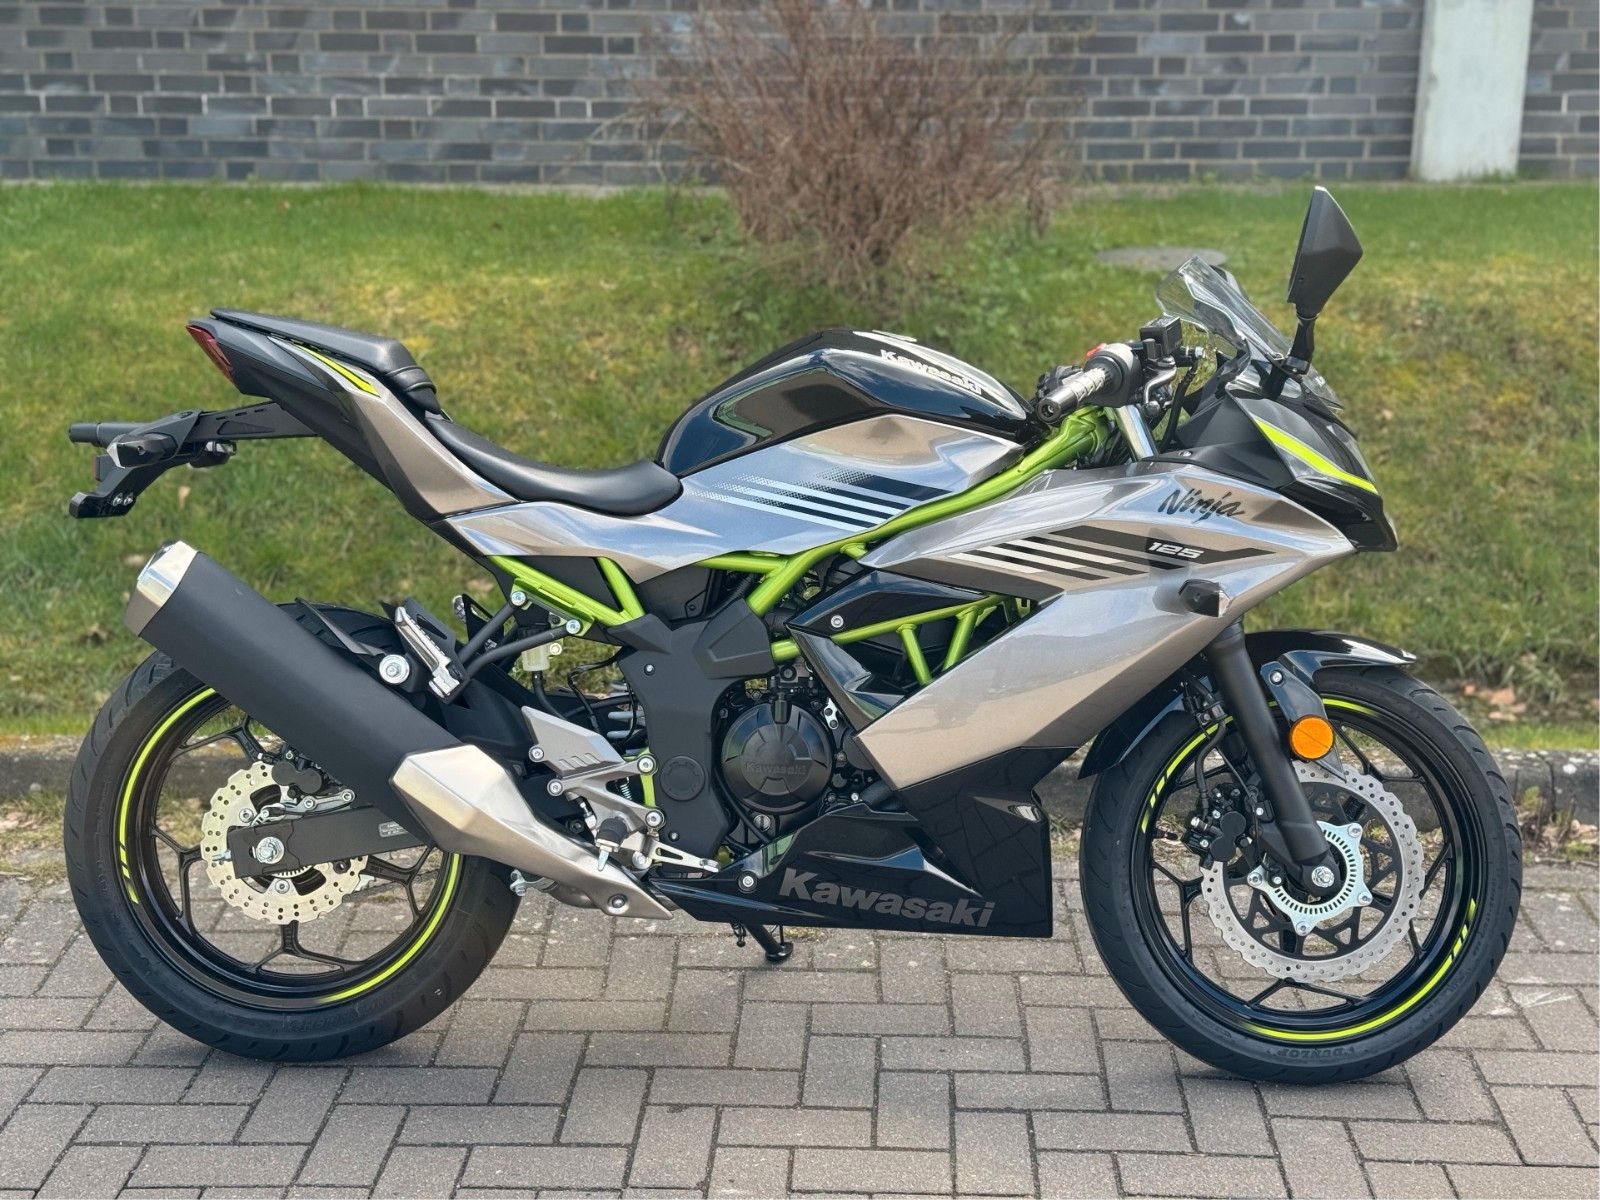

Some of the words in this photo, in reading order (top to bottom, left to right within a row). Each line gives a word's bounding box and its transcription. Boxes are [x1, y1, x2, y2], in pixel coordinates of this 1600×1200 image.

[880, 349, 983, 395] Kawasaki
[1157, 488, 1245, 524] Ninja
[1148, 542, 1205, 559] 125
[778, 867, 996, 928] Kawasaki
